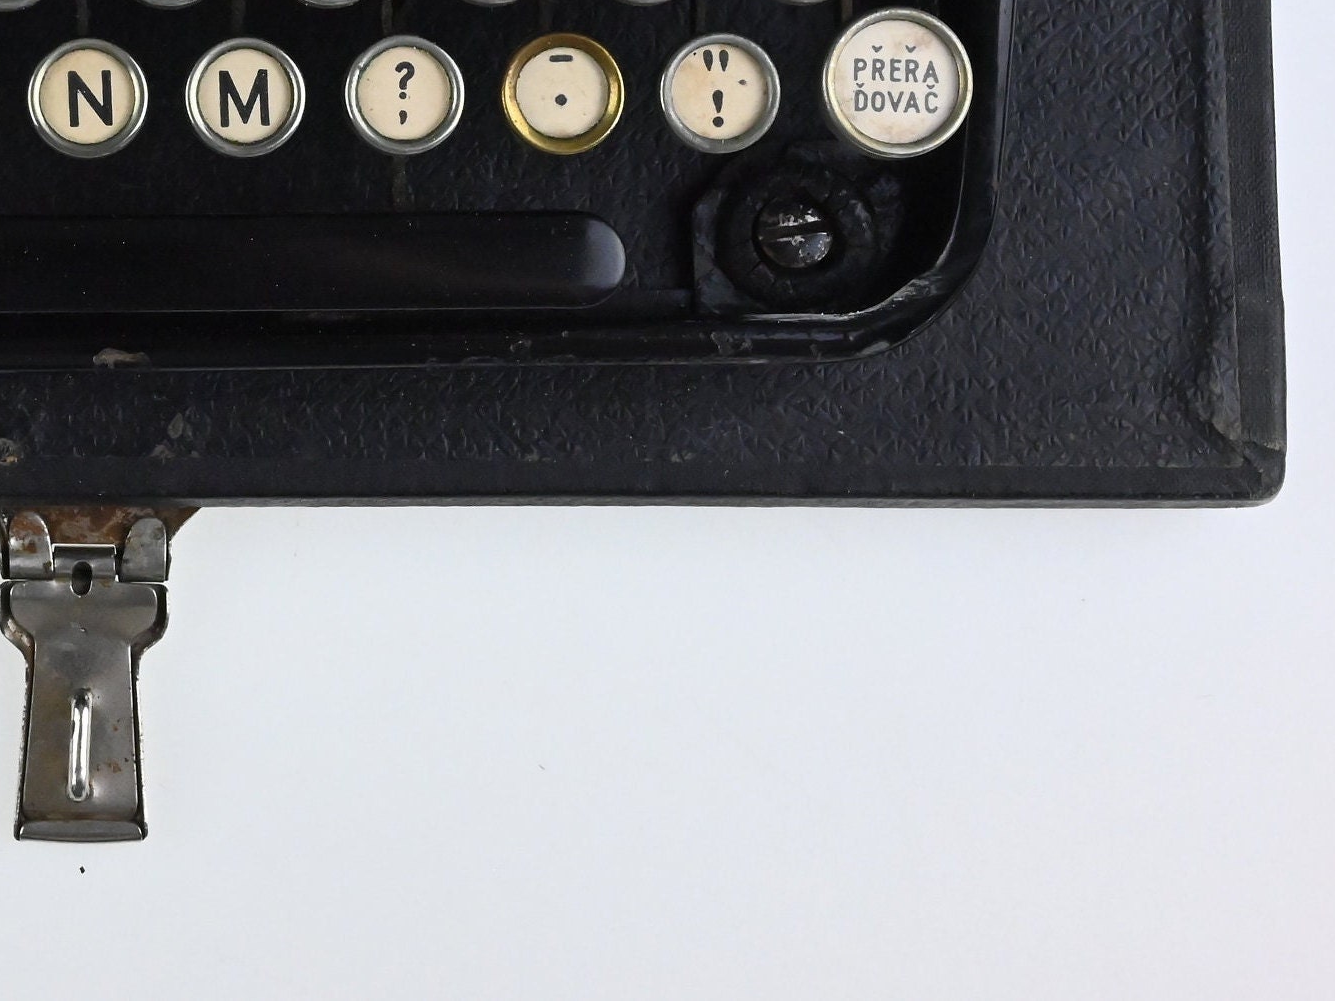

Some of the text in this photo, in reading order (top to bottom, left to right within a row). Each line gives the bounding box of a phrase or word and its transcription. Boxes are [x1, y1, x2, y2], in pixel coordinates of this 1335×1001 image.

[67, 69, 114, 128] N
[218, 68, 271, 128] M
[394, 61, 415, 100] ?
[712, 89, 725, 128] !
